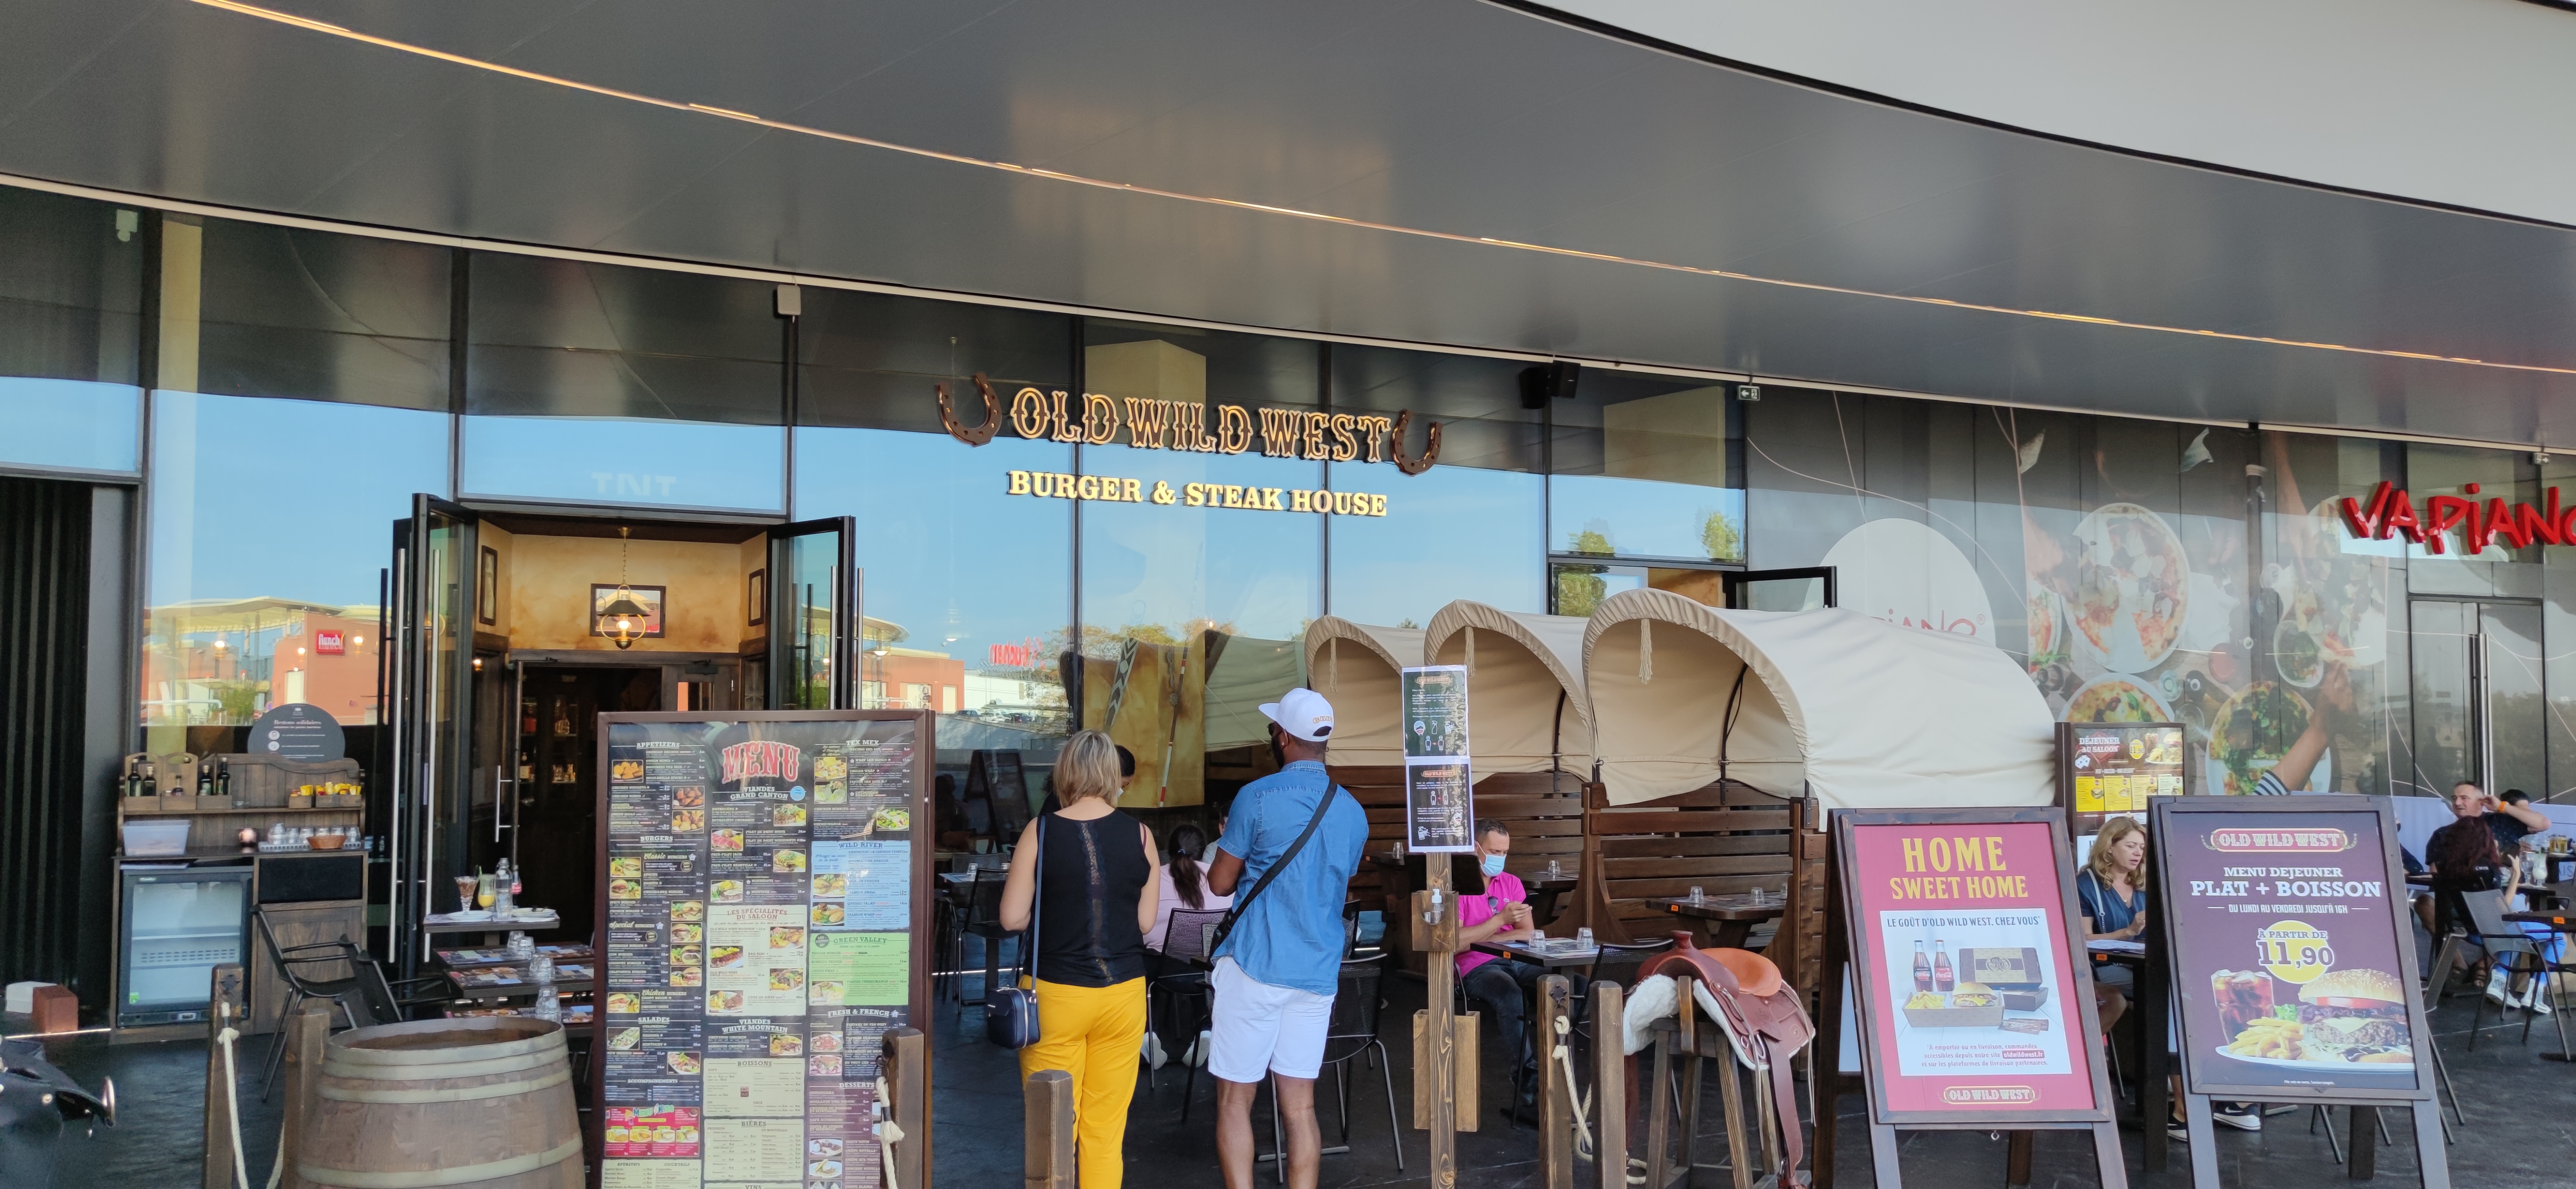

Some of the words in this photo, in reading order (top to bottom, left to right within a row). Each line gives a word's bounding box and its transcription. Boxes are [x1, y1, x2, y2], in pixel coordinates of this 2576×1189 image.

[1010, 387, 1120, 445] OLD
[1124, 396, 1253, 454] WILD
[1258, 407, 1392, 463] WEST
[592, 472, 677, 497] TNT
[1007, 470, 1143, 503] BURGER
[1153, 480, 1176, 505] &
[1183, 483, 1284, 511] STEAK
[1289, 489, 1388, 517] HOUSE
[722, 740, 800, 784] MENU
[2219, 833, 2251, 847] OLD
[2252, 833, 2294, 847] WILD
[2295, 833, 2340, 847] WEST
[1901, 837, 2007, 872] HOME
[2223, 867, 2267, 878] MENU
[2270, 867, 2343, 879] DEJEUNER
[1890, 877, 1960, 900] SWEET
[1966, 875, 2028, 898] HOME
[2190, 881, 2249, 897] PLAT
[2255, 883, 2270, 895] +
[2276, 881, 2382, 897] BOISSON
[2229, 904, 2238, 913] DU
[2239, 904, 2260, 913] LUNDI
[2260, 905, 2271, 913] AU
[2271, 905, 2304, 914] VENDREDI
[2335, 905, 2348, 914] 16H
[1888, 918, 1897, 928] LE
[1899, 916, 1921, 928] GOÛT
[1922, 917, 1946, 927] D'OLD
[1947, 917, 1968, 927] WILD
[1996, 917, 2015, 926] CHEZ
[2269, 931, 2310, 939] PARTIR
[2312, 930, 2328, 939] DE
[2256, 940, 2335, 970] 11,90
[827, 1009, 851, 1017] FRESH
[1949, 1090, 1970, 1100] OLD
[1972, 1089, 1999, 1100] WILD
[2000, 1089, 2030, 1100] WEST
[633, 1107, 653, 1117] MENU
